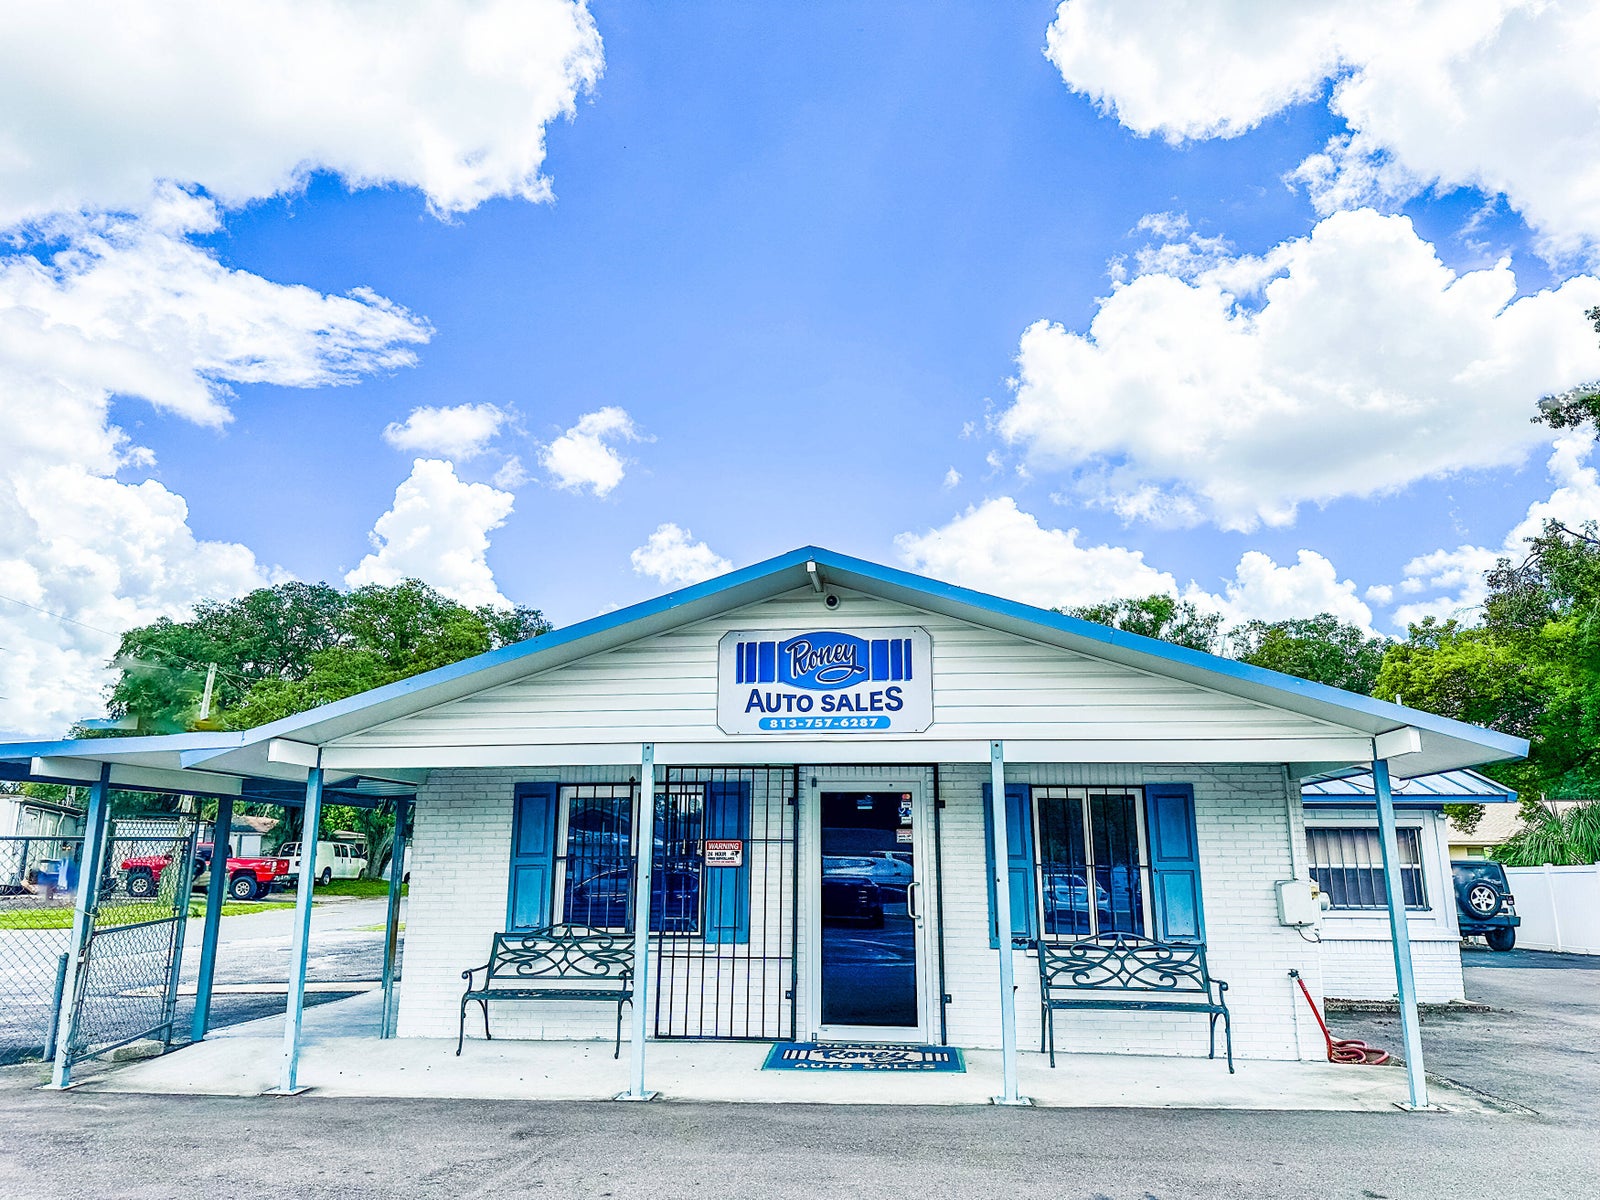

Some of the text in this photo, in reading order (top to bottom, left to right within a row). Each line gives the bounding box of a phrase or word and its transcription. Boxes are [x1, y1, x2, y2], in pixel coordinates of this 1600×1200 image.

[785, 639, 865, 683] Roney
[745, 686, 904, 713] AUTO SALES
[769, 718, 879, 728] 813-757-6287
[814, 1049, 915, 1063] Roney
